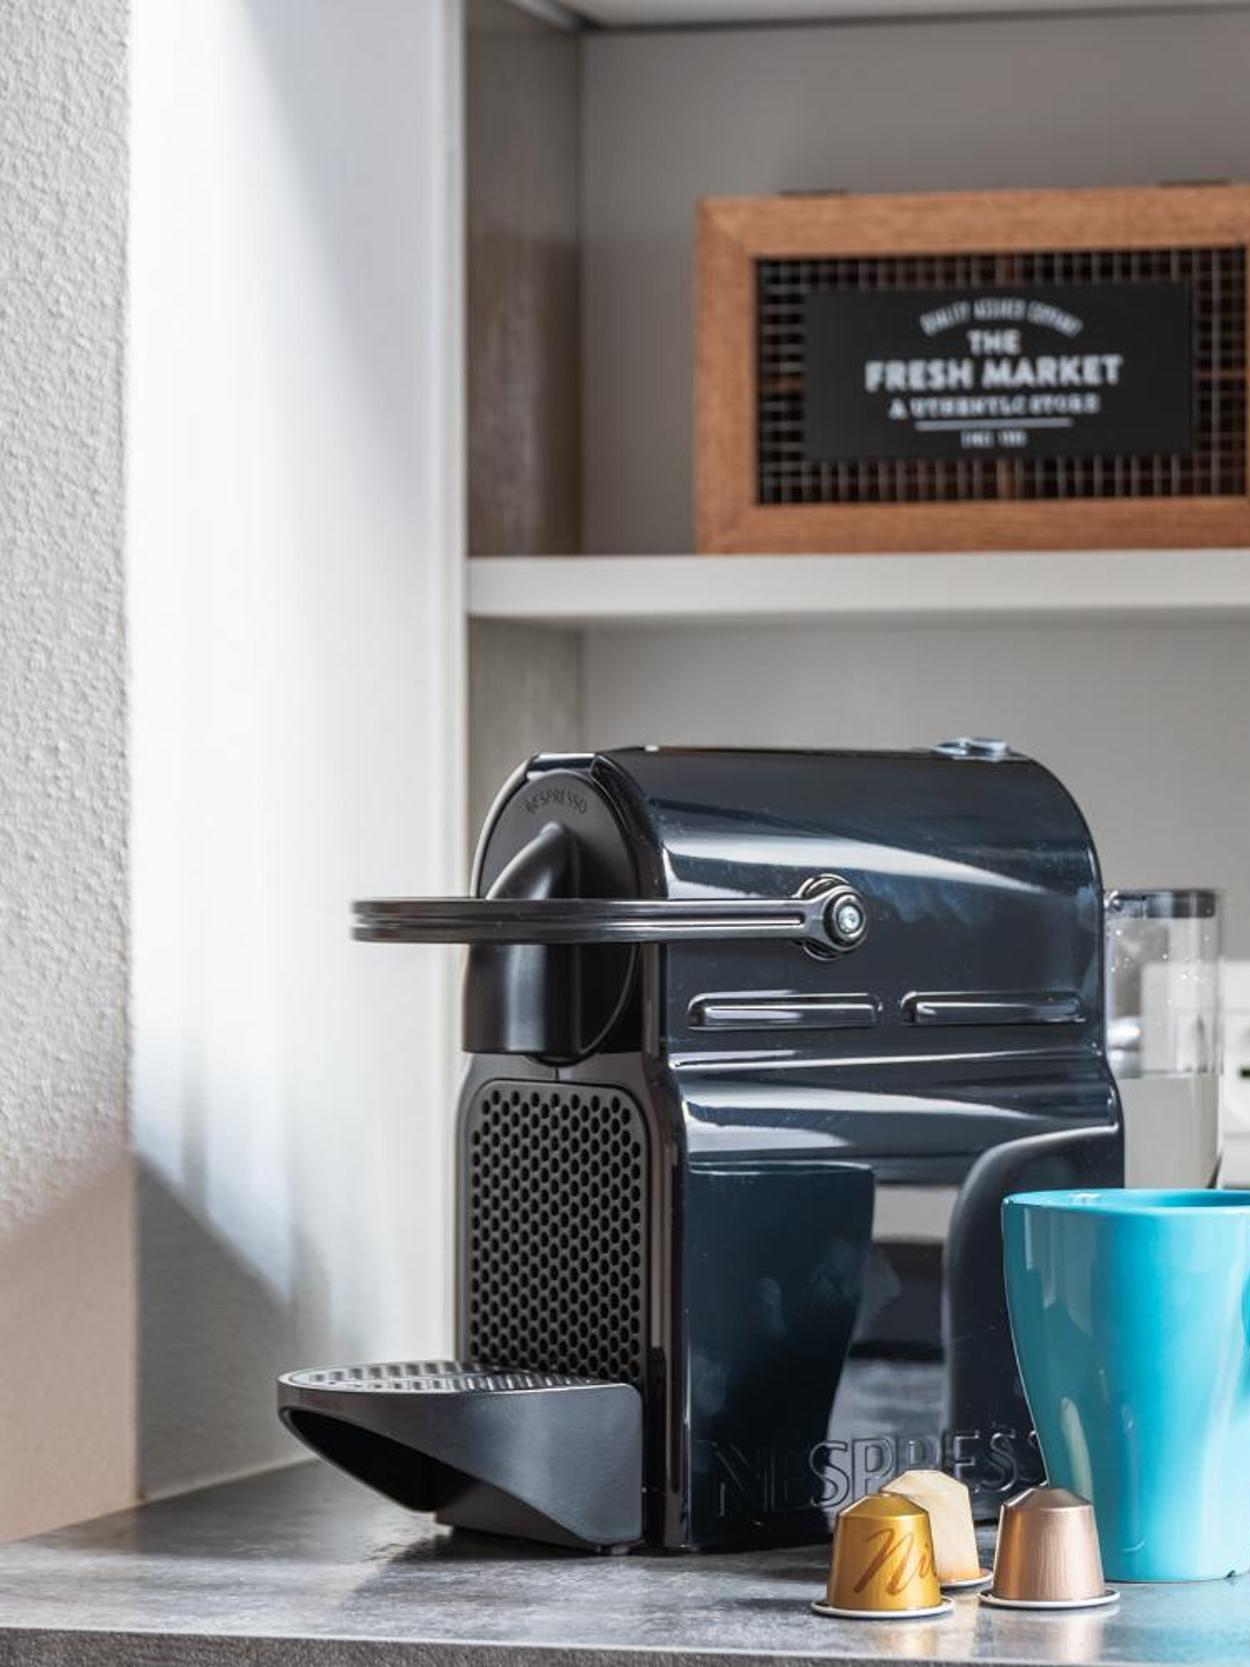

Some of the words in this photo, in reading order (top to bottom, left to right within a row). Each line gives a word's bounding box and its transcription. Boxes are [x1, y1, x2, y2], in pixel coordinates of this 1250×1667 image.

[967, 330, 1021, 355] THE
[865, 361, 972, 392] FRESH
[982, 355, 1122, 386] MARKET
